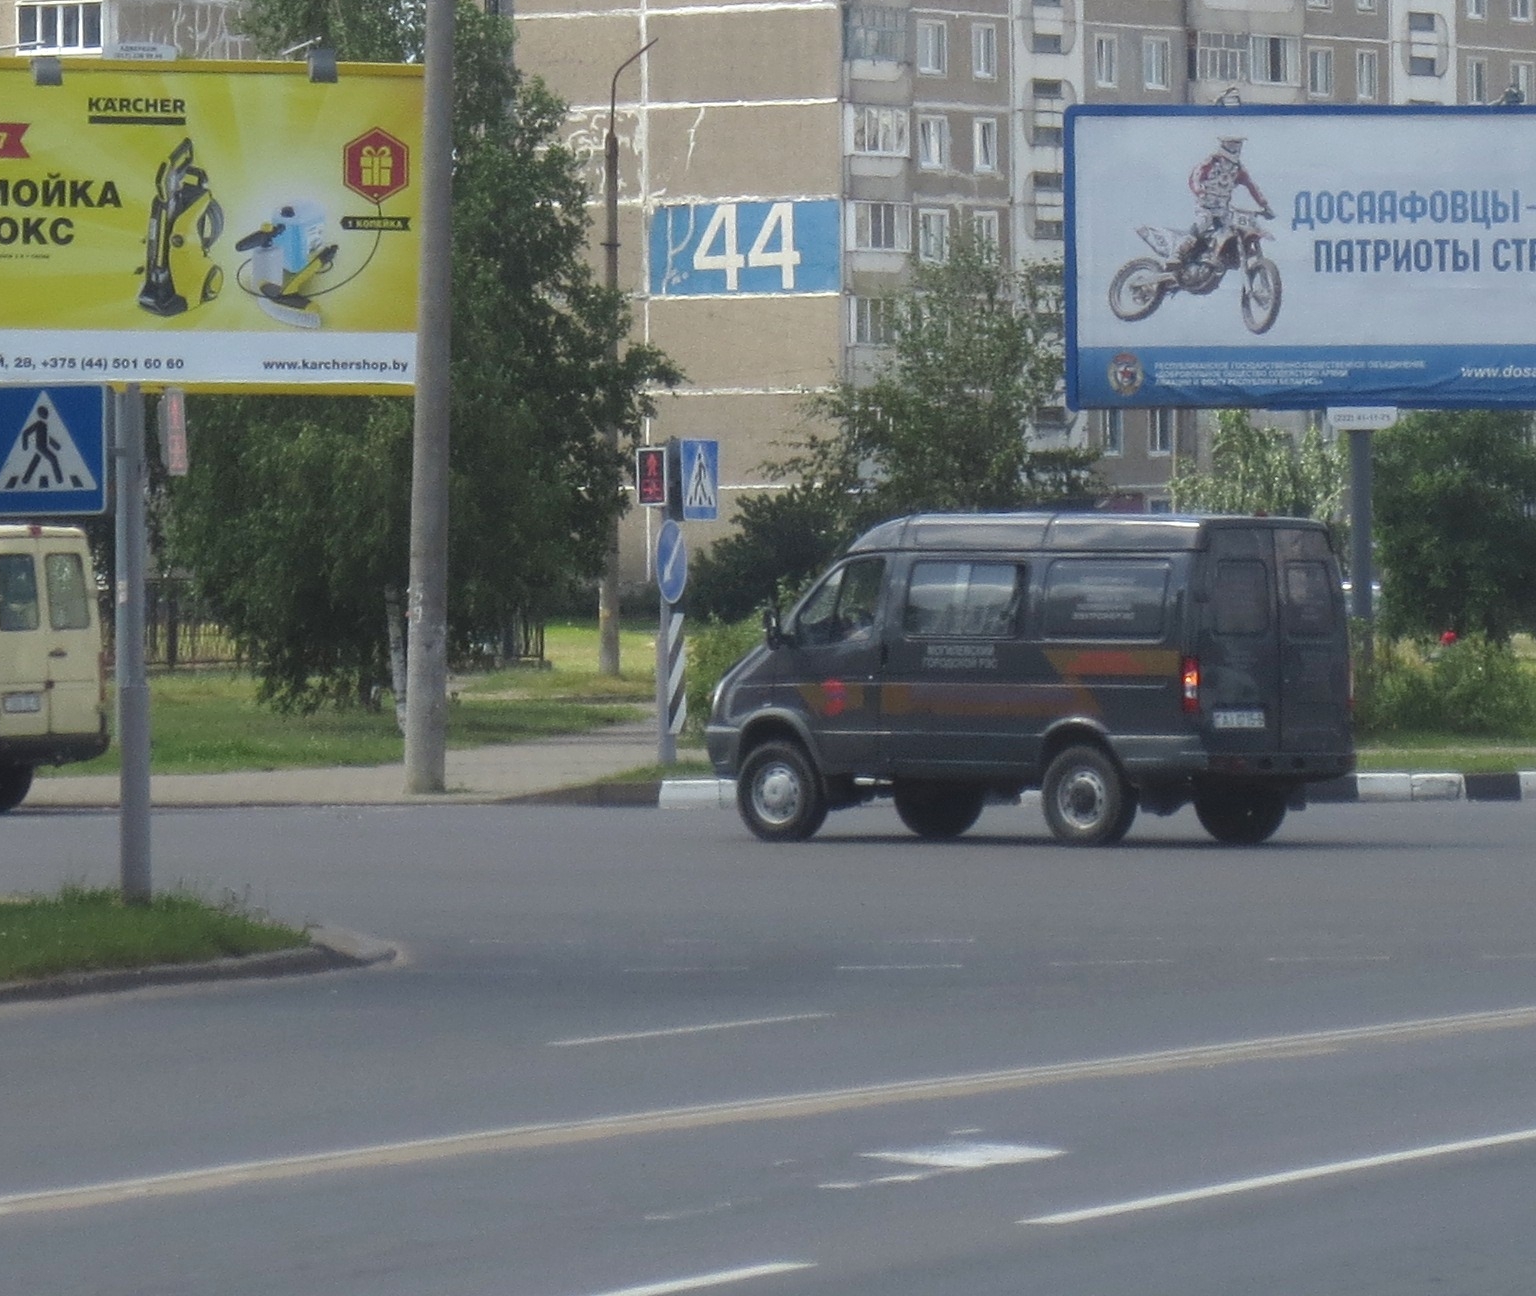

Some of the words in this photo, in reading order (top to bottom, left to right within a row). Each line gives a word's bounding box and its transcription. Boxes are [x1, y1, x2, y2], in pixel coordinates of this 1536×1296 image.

[88, 97, 186, 113] KÄRCHER
[1291, 190, 1521, 230] ДОСААФОВЦЫ
[692, 202, 802, 291] 44
[1314, 238, 1480, 272] ПАТРИОТЫ
[41, 358, 76, 368] +375
[81, 357, 108, 371] (44)
[112, 358, 138, 369] 501
[144, 358, 162, 369] 60
[263, 359, 408, 372] www.karchershop.by
